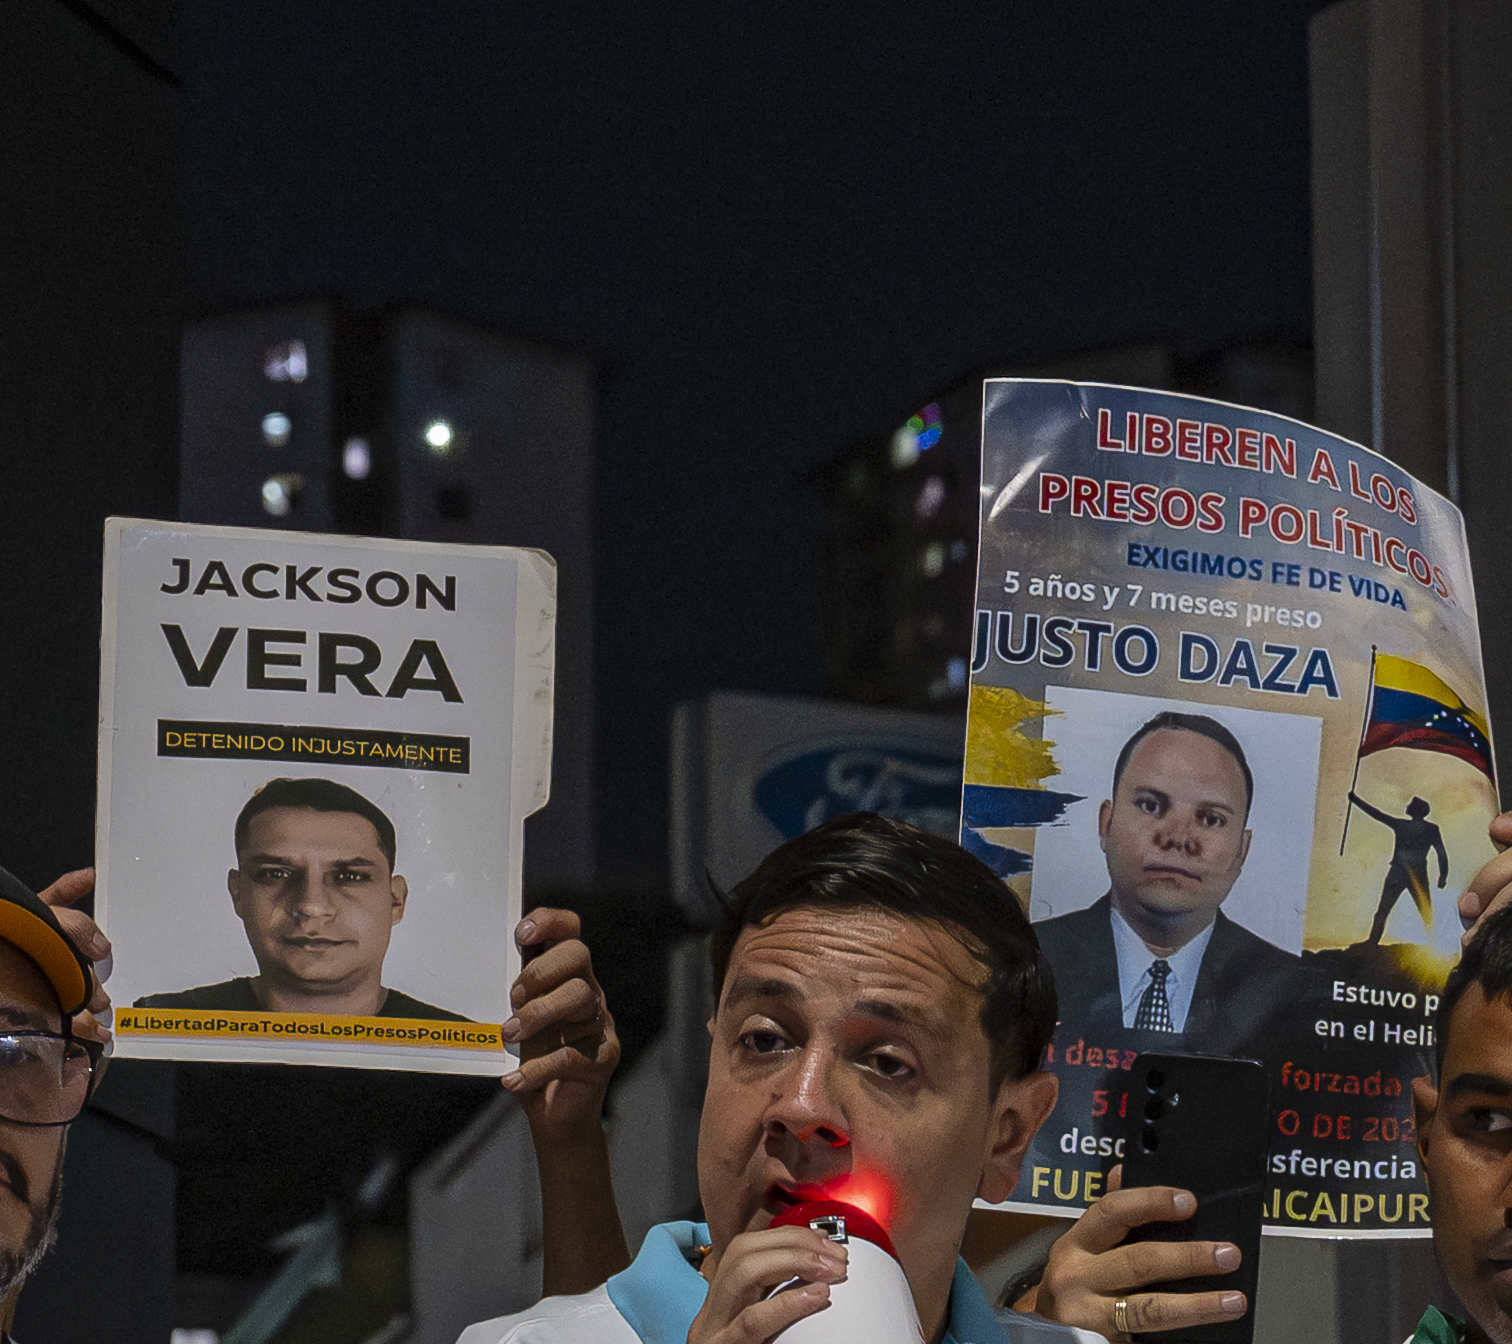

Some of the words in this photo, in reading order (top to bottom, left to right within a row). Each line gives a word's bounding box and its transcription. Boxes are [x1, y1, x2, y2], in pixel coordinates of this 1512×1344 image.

[1097, 408, 1297, 479] LIBEREN
[1308, 448, 1342, 492] A
[1348, 460, 1417, 525] LOS
[1038, 472, 1226, 533] PRESOS
[1239, 497, 1454, 602] POLÍTICOS
[159, 557, 457, 612] JACKSON
[1127, 543, 1263, 581] EXIGIMOS
[1271, 561, 1300, 587] FE
[1309, 567, 1342, 593] DE
[1348, 574, 1407, 611] VIDA
[1003, 570, 1020, 593] 5
[1029, 574, 1096, 602] años
[1102, 584, 1120, 610] y
[1127, 584, 1144, 607] 7
[1150, 591, 1238, 619] meses
[1246, 602, 1323, 629] preso
[159, 623, 465, 704] VERA
[971, 609, 1160, 677] JUSTO
[1178, 631, 1341, 700] DAZA
[165, 731, 285, 752] DETENIDO
[291, 736, 462, 763] INJUSTAMENTE
[1332, 980, 1417, 1009] Estuvo
[1314, 1018, 1345, 1038] en
[1353, 1019, 1375, 1042] el
[1383, 1022, 1437, 1047] Heli
[1281, 1061, 1403, 1097] forzada
[1091, 1090, 1111, 1117] 5
[1313, 1113, 1352, 1141] DE
[1362, 1116, 1417, 1144] 202
[1032, 1165, 1104, 1203] FUE
[1271, 1150, 1417, 1180] sferencia
